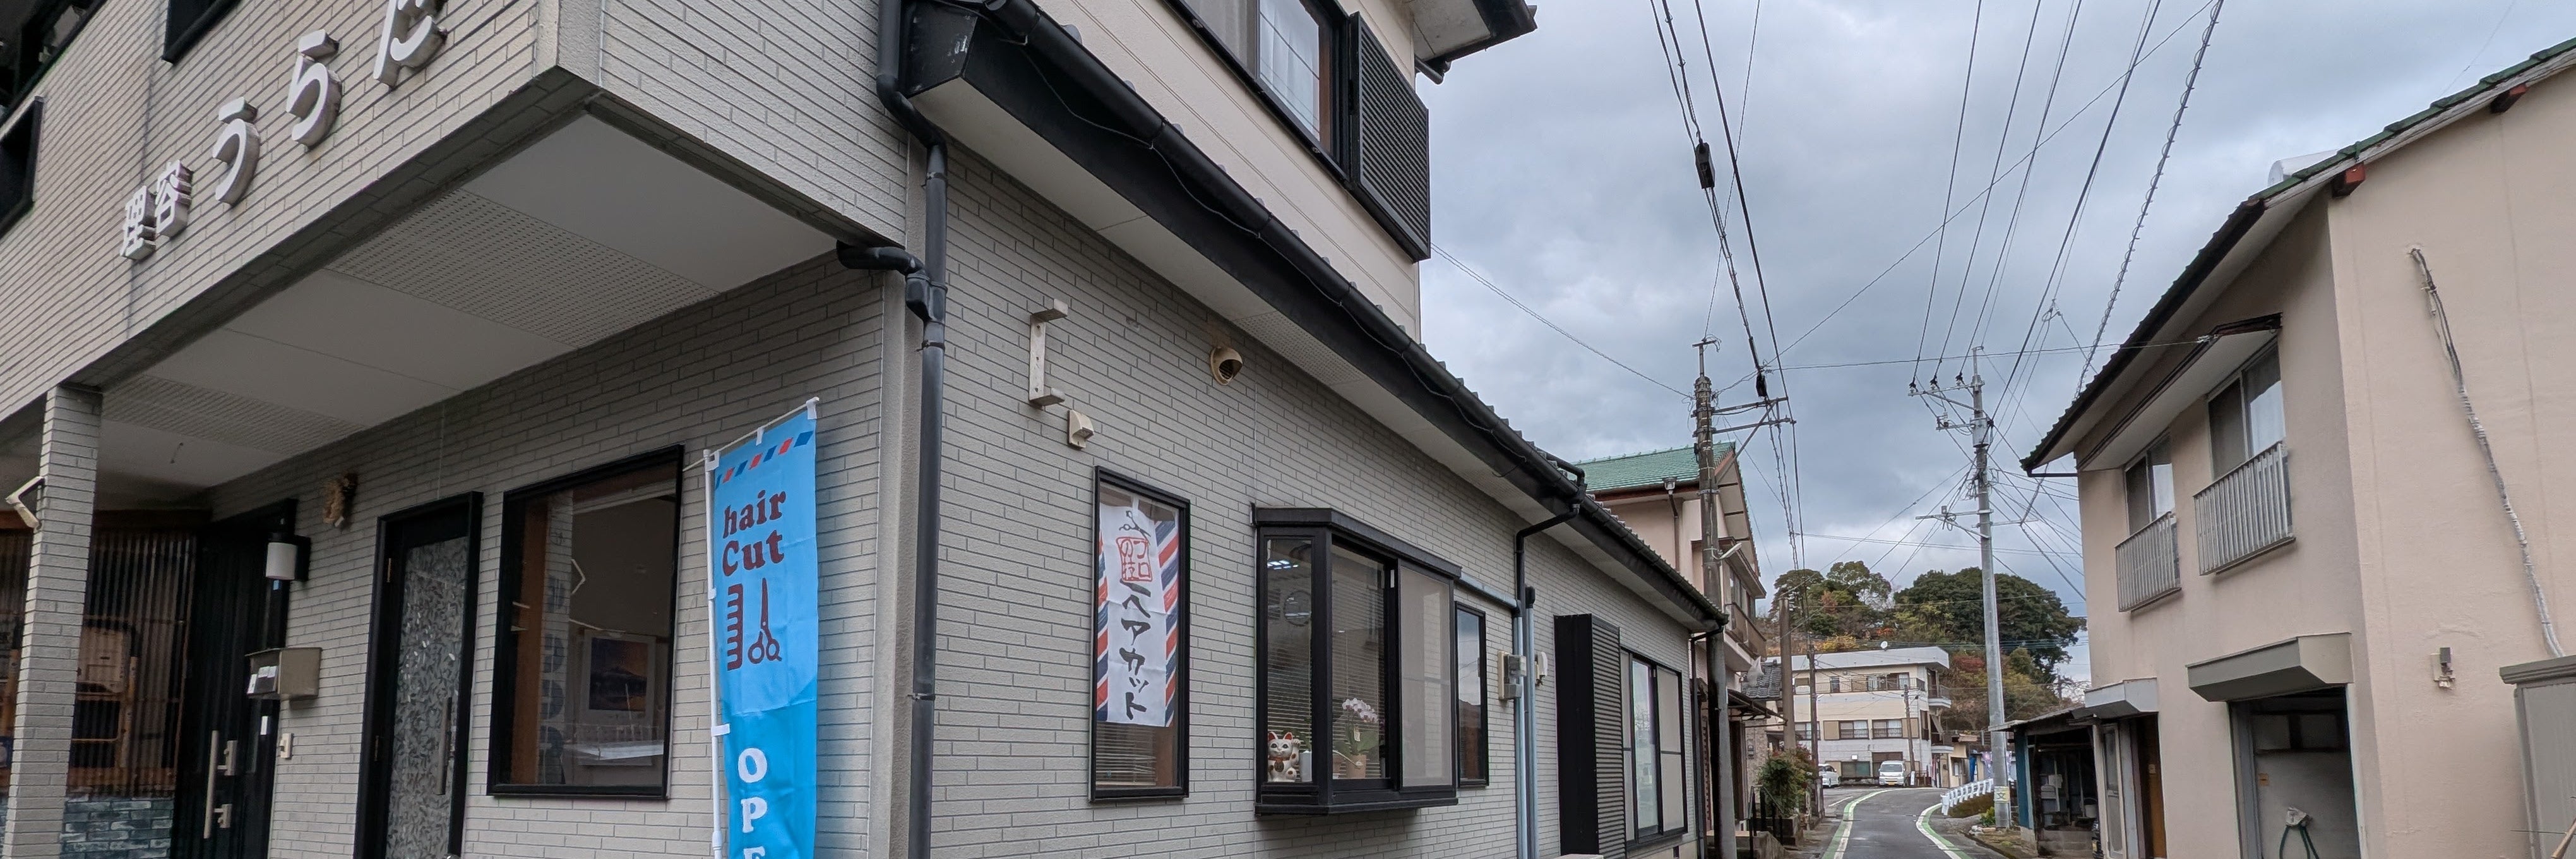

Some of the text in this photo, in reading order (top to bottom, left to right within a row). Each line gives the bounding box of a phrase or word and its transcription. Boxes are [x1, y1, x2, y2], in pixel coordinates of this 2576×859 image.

[723, 490, 786, 539] hair
[722, 529, 784, 577] Cut
[1119, 594, 1151, 720] ヘアカット
